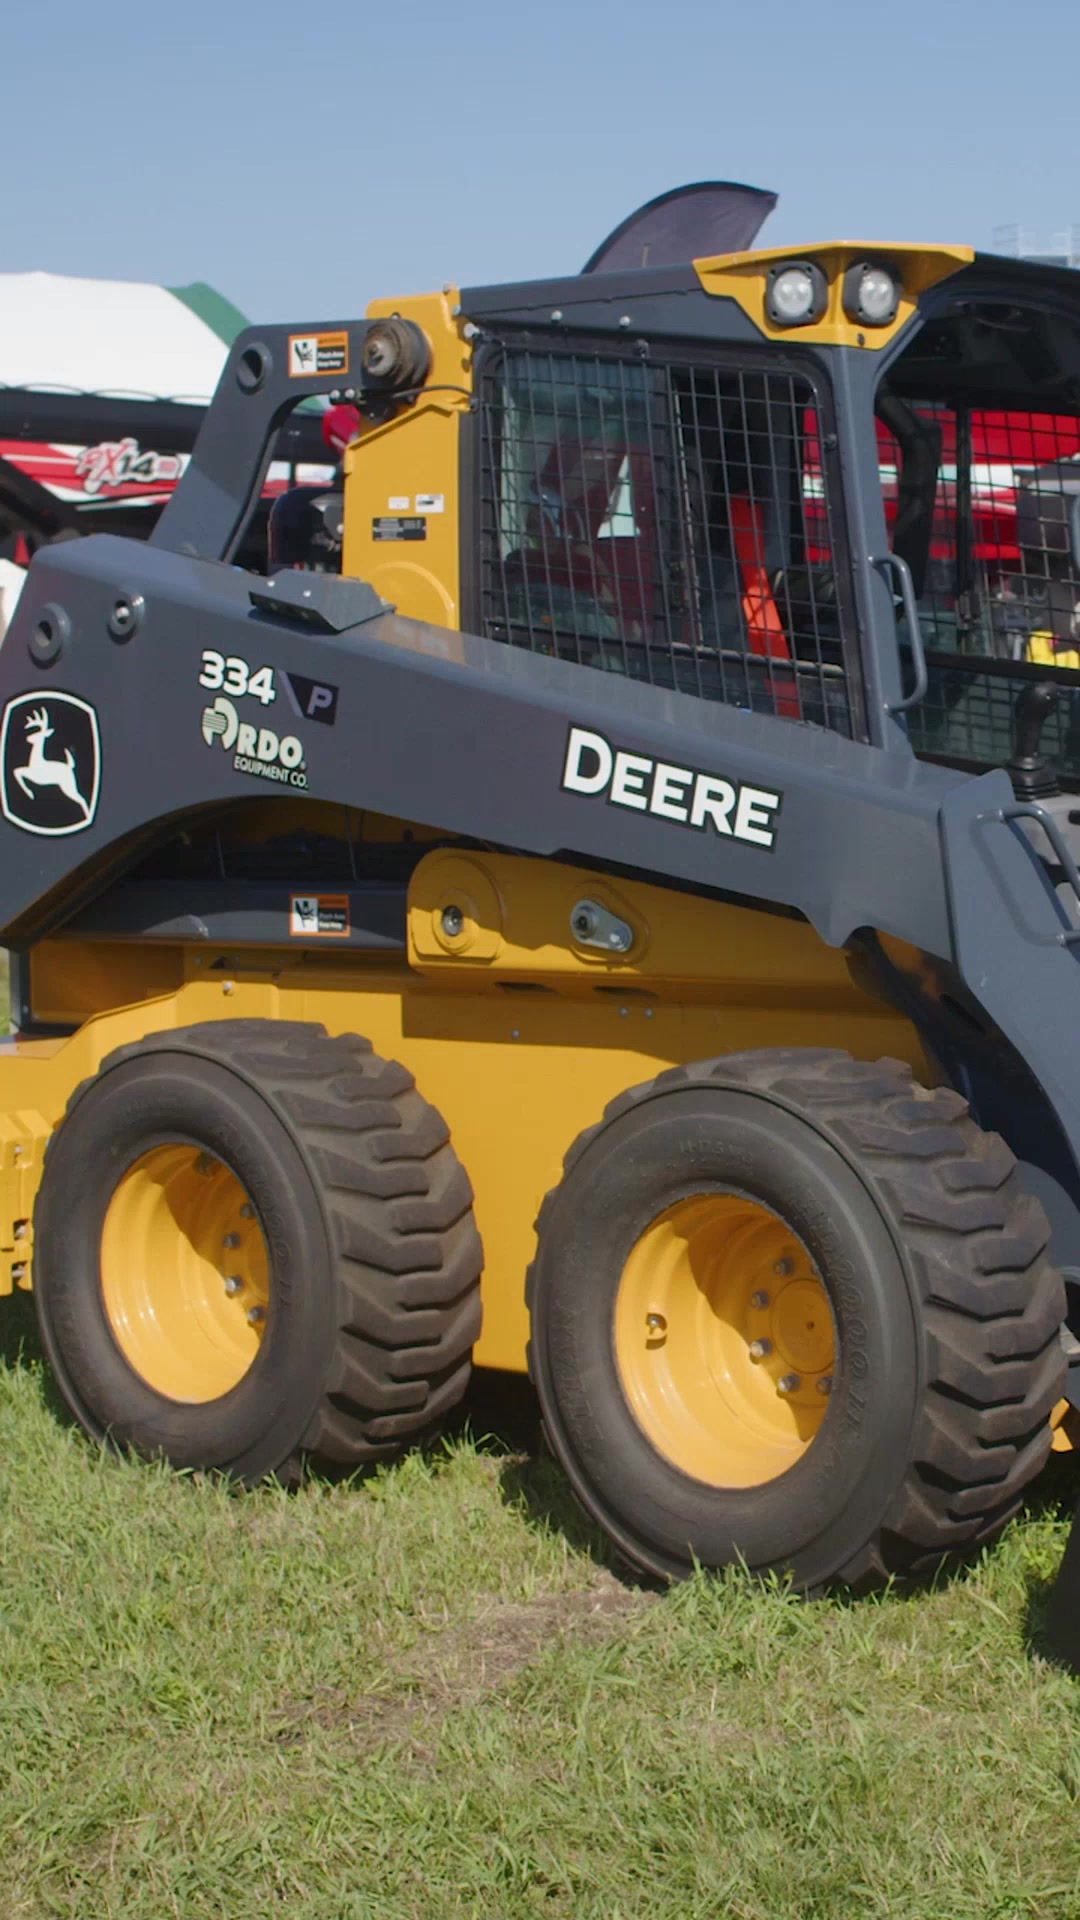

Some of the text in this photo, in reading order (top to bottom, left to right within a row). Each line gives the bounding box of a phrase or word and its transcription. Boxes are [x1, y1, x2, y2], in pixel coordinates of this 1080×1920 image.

[199, 649, 333, 716] 334 P
[233, 754, 309, 788] EQUIPMENT CO.
[563, 727, 779, 847] DEERE
